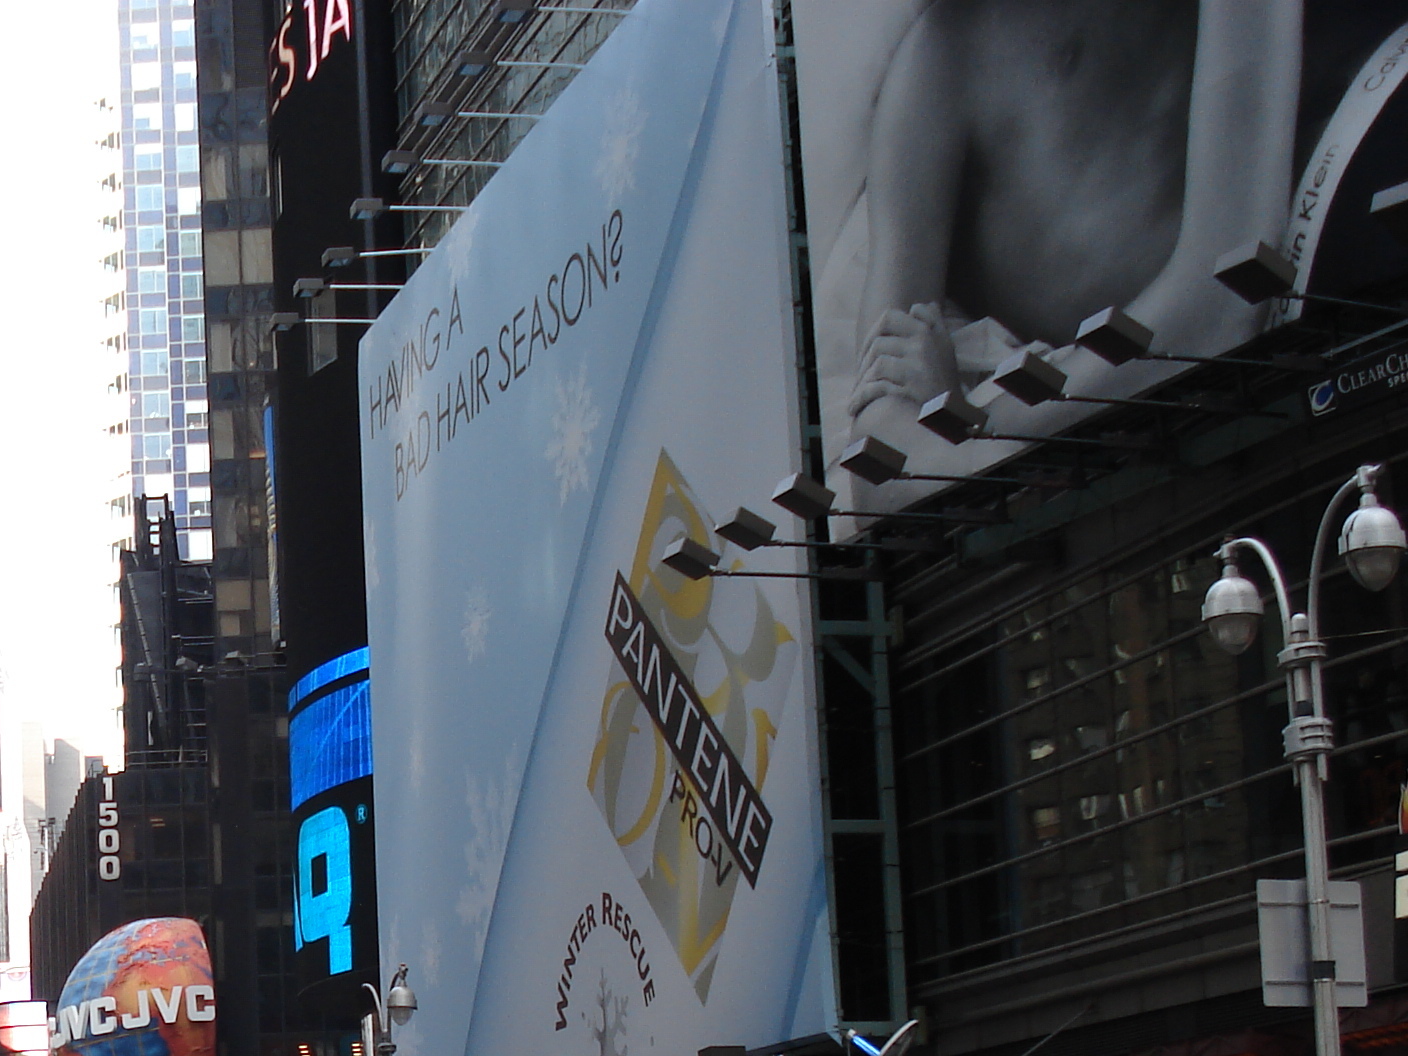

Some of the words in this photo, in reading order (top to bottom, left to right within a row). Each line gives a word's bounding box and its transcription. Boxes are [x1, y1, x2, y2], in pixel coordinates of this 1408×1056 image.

[369, 307, 441, 440] HAVING
[447, 283, 463, 351] A
[395, 410, 430, 502] BAD
[437, 346, 490, 452] HAIR
[498, 209, 623, 392] SEASON?
[609, 584, 766, 873] PANTENE
[98, 776, 121, 881] 1500
[669, 769, 732, 887] PRO-V
[49, 996, 117, 1050] JVC
[122, 984, 216, 1030] JVC
[555, 903, 597, 1032] WINTER
[601, 892, 656, 1008] RESCUE
